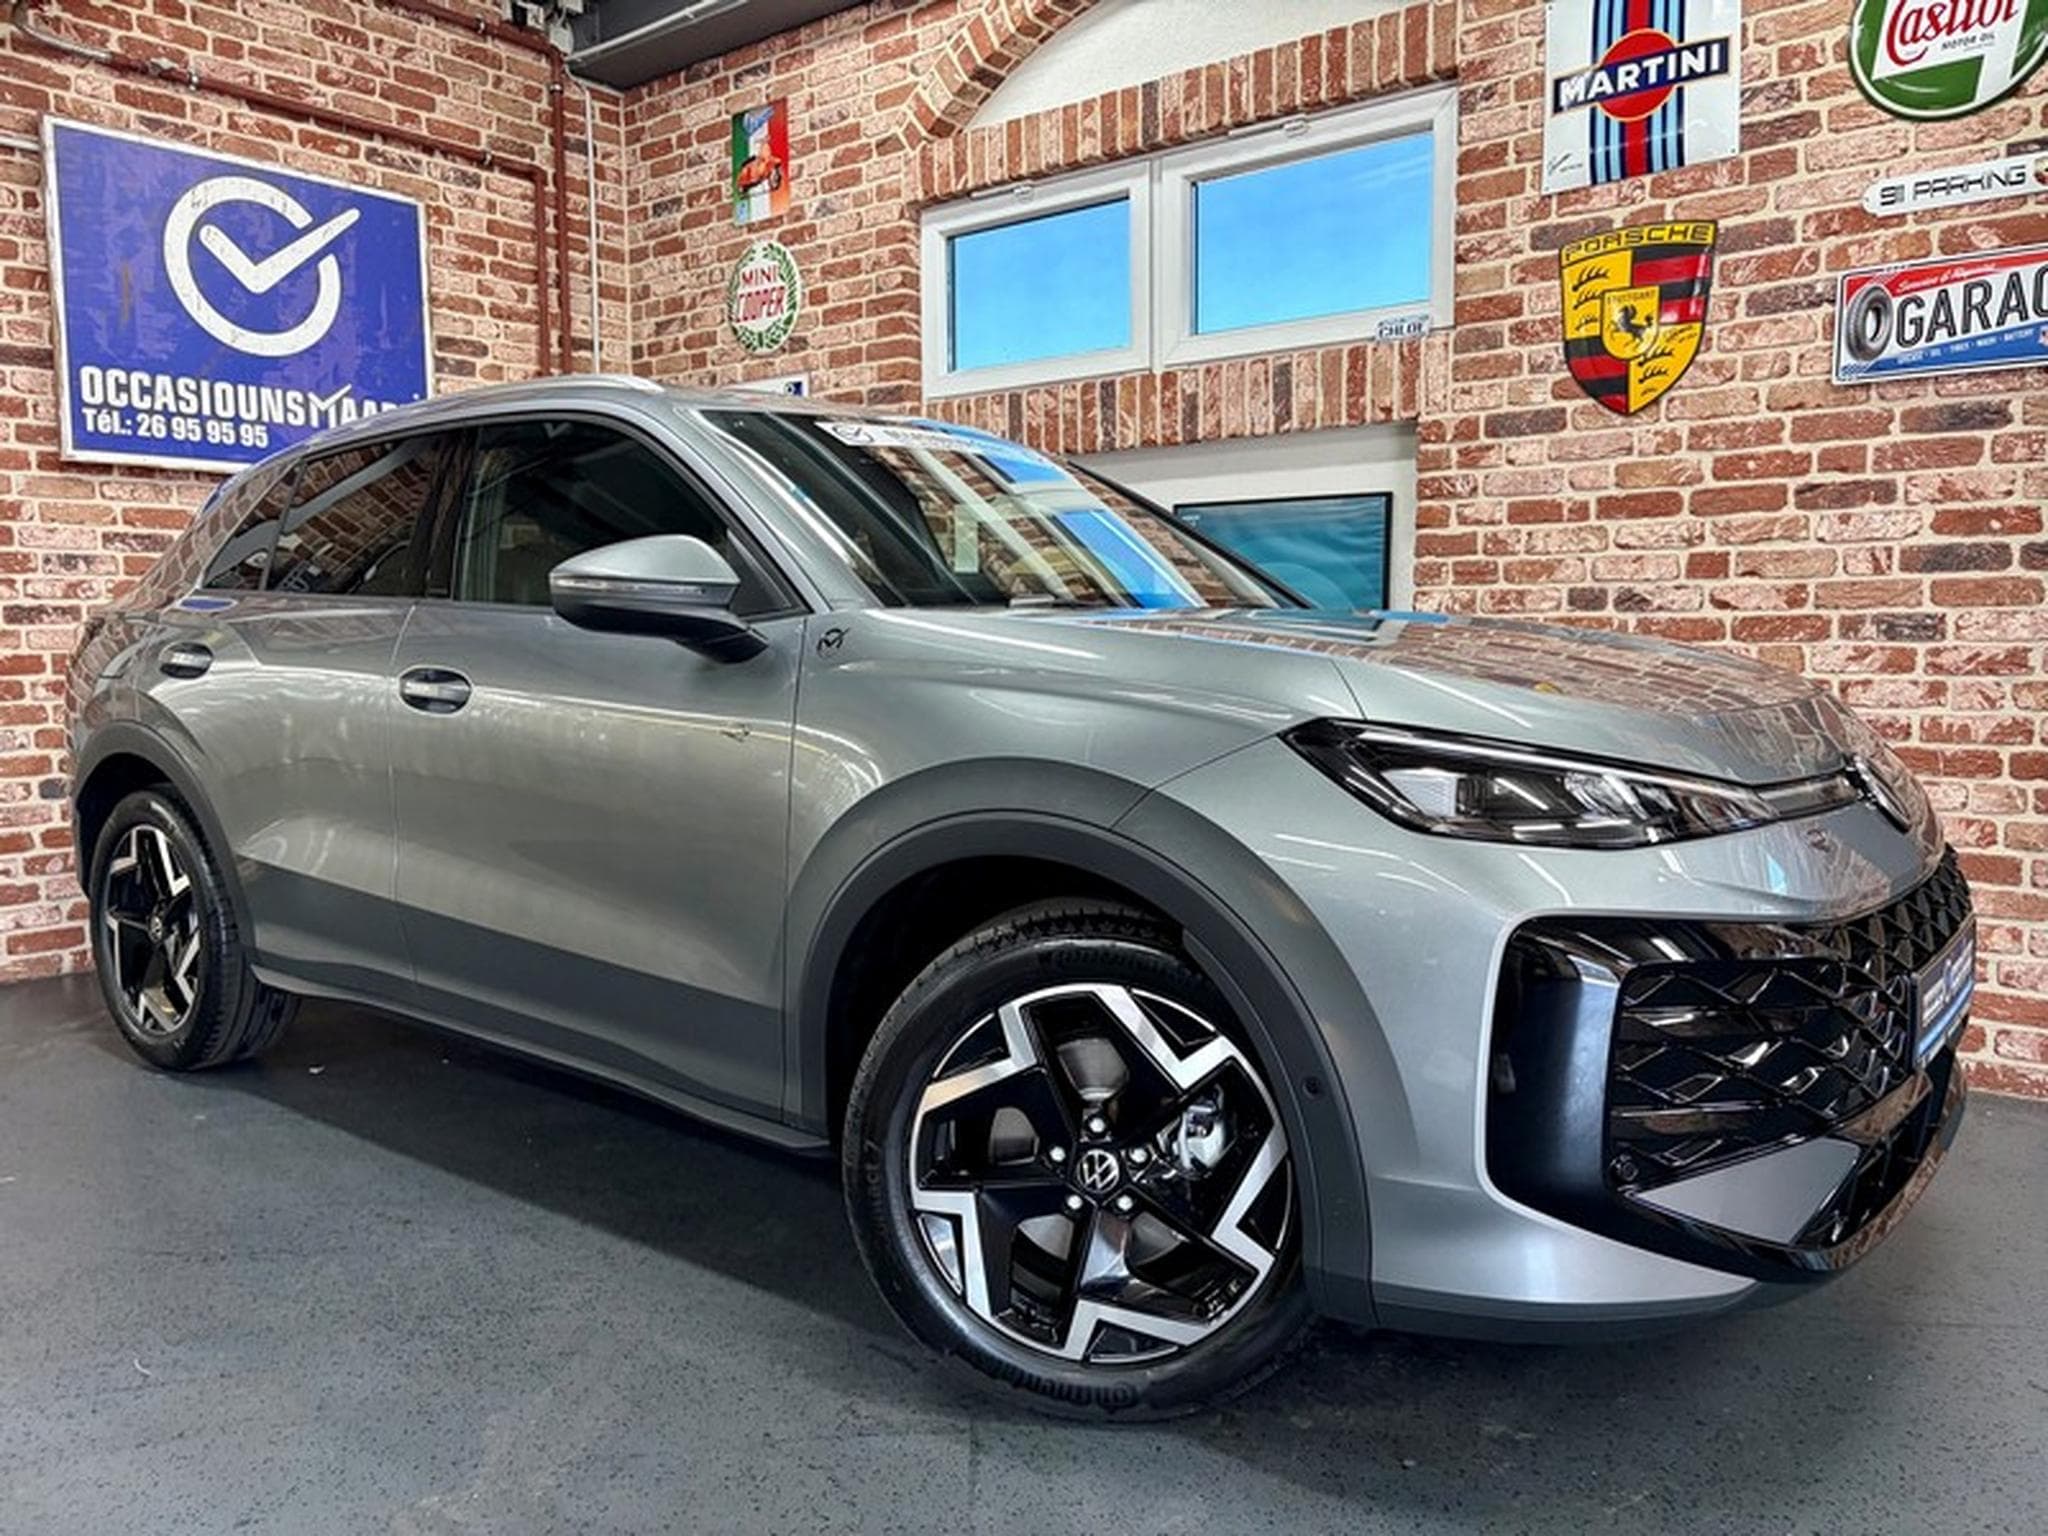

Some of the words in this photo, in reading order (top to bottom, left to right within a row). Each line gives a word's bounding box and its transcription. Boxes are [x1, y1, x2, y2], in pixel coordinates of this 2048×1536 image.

[1941, 34, 1977, 51] MOTOR
[1979, 31, 1995, 42] OIL
[1559, 43, 1720, 108] MARTINI
[1913, 165, 2027, 201] PARKING
[1565, 224, 1711, 262] PORSCHE
[741, 264, 778, 287] MINI
[736, 286, 785, 323] COOPER
[79, 366, 399, 429] OCCASIOUNSMA
[82, 408, 132, 434] Tél.:
[138, 414, 167, 438] 26
[171, 418, 202, 442] 95
[206, 421, 236, 445] 95
[239, 424, 269, 448] 95
